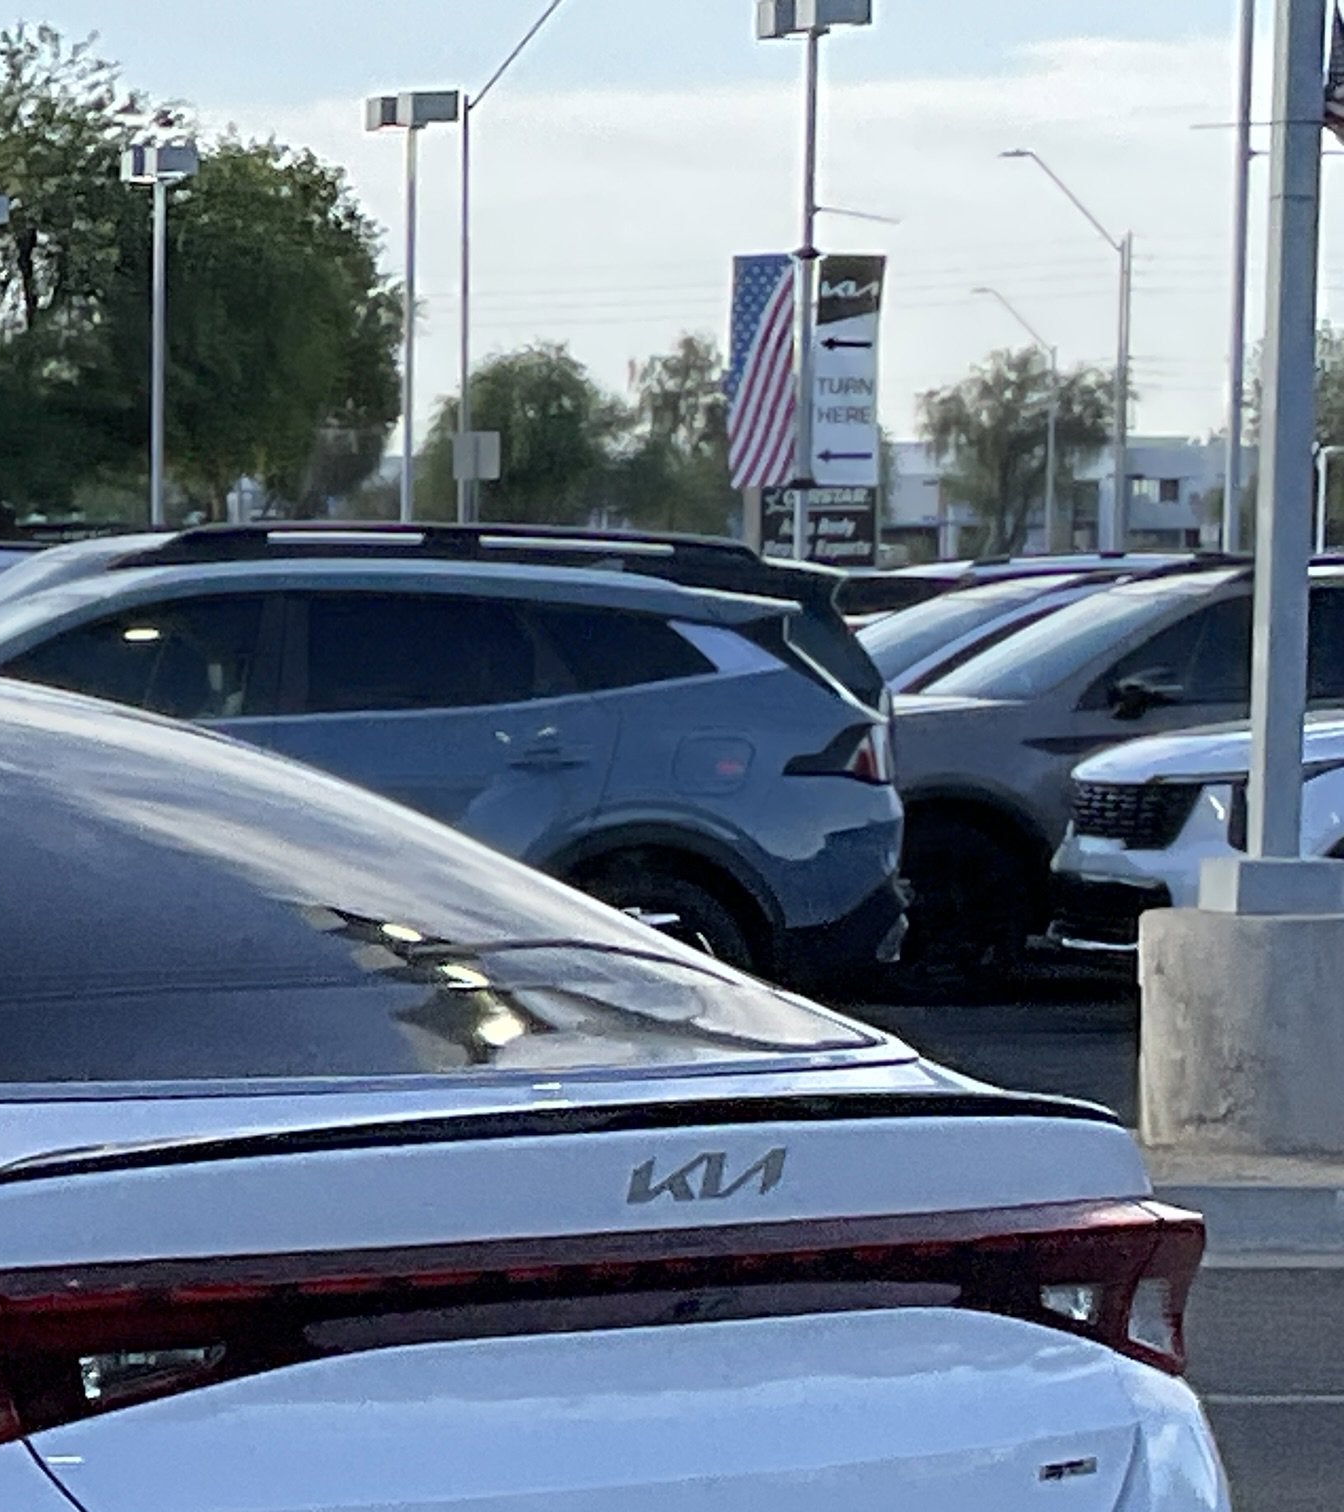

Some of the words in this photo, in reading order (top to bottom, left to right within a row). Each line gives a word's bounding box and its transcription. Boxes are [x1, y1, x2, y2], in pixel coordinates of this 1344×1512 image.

[817, 377, 873, 395] TURN
[818, 406, 870, 423] HERE
[783, 488, 868, 504] CRSTAR
[627, 1146, 786, 1205] KIA
